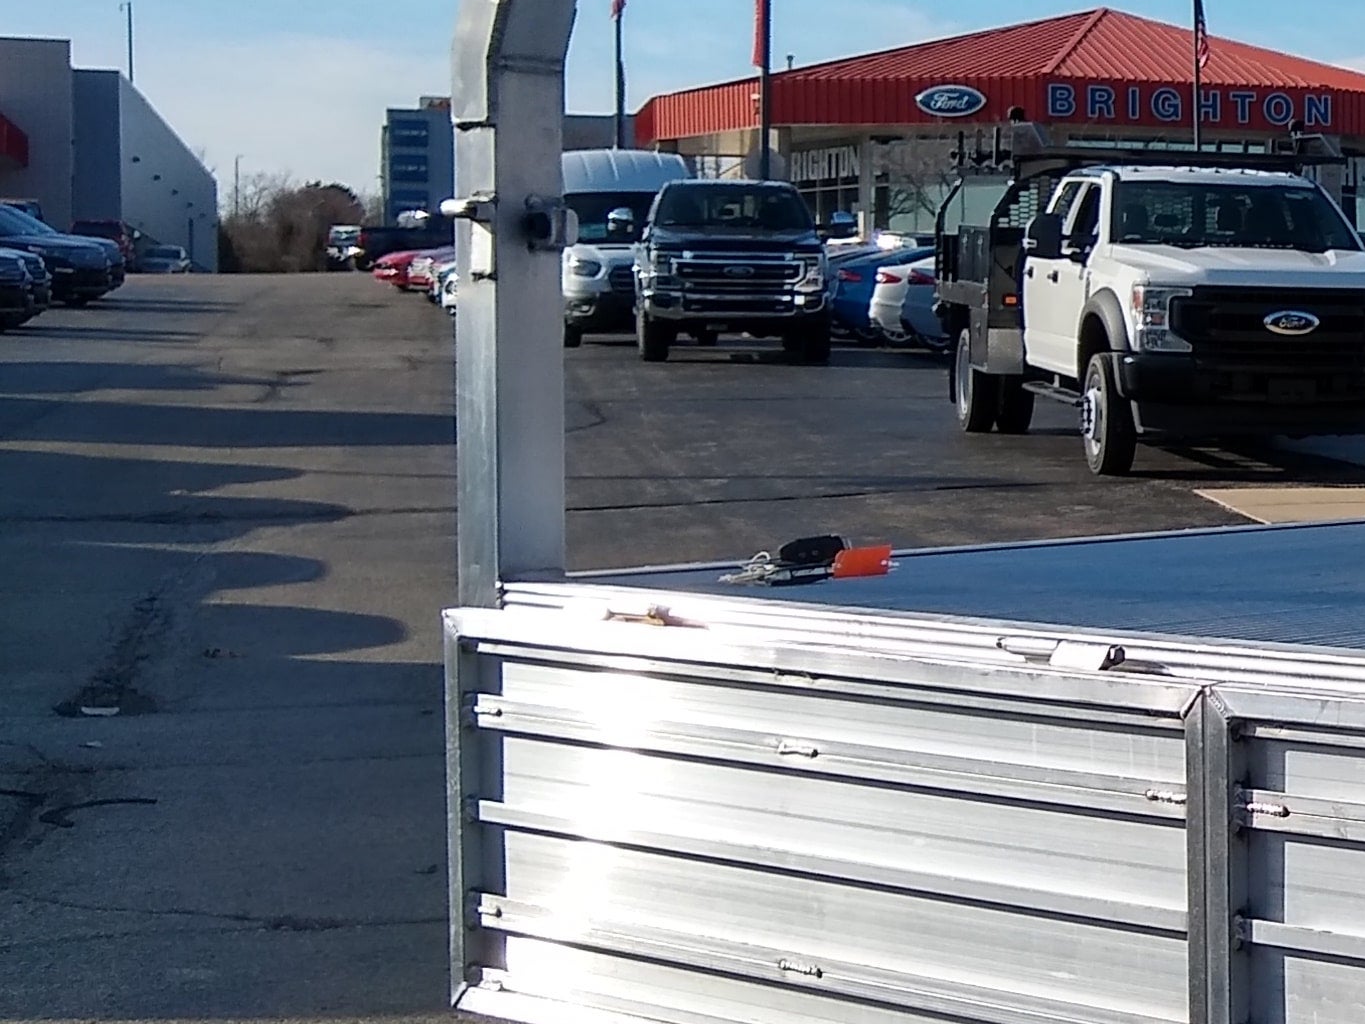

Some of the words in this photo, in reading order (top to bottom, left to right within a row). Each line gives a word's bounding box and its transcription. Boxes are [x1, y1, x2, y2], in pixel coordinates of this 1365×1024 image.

[930, 92, 969, 109] Ford
[1048, 83, 1332, 126] BRIGHTON
[791, 144, 860, 182] RIGHTON
